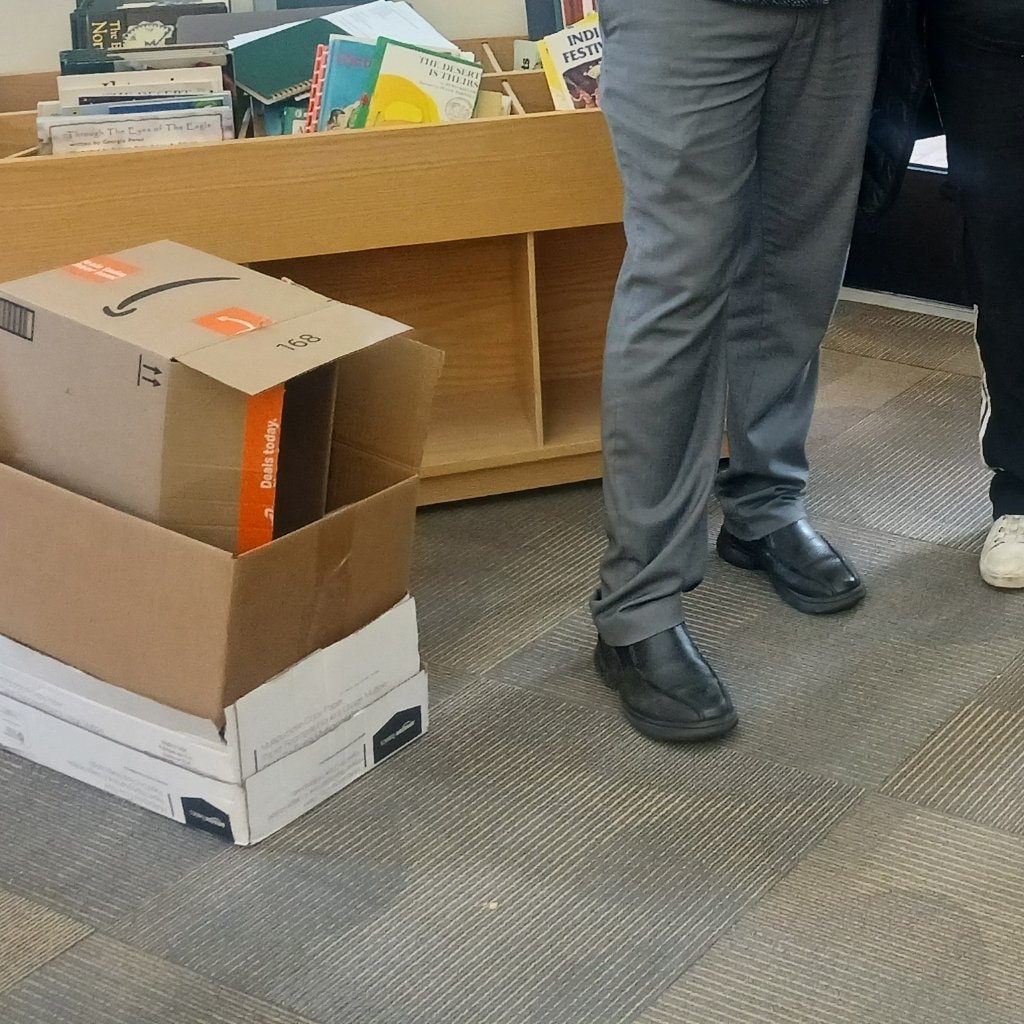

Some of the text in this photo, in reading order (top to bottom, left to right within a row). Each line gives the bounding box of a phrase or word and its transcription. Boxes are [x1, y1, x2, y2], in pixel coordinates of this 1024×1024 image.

[419, 56, 481, 80] THE DESERT
[428, 68, 479, 88] IS THEIRS
[107, 127, 125, 136] The
[128, 126, 151, 136] Eyes
[165, 123, 183, 132] The
[186, 122, 212, 132] Eagle
[276, 334, 321, 351] 168
[259, 418, 280, 489] Deals today.
